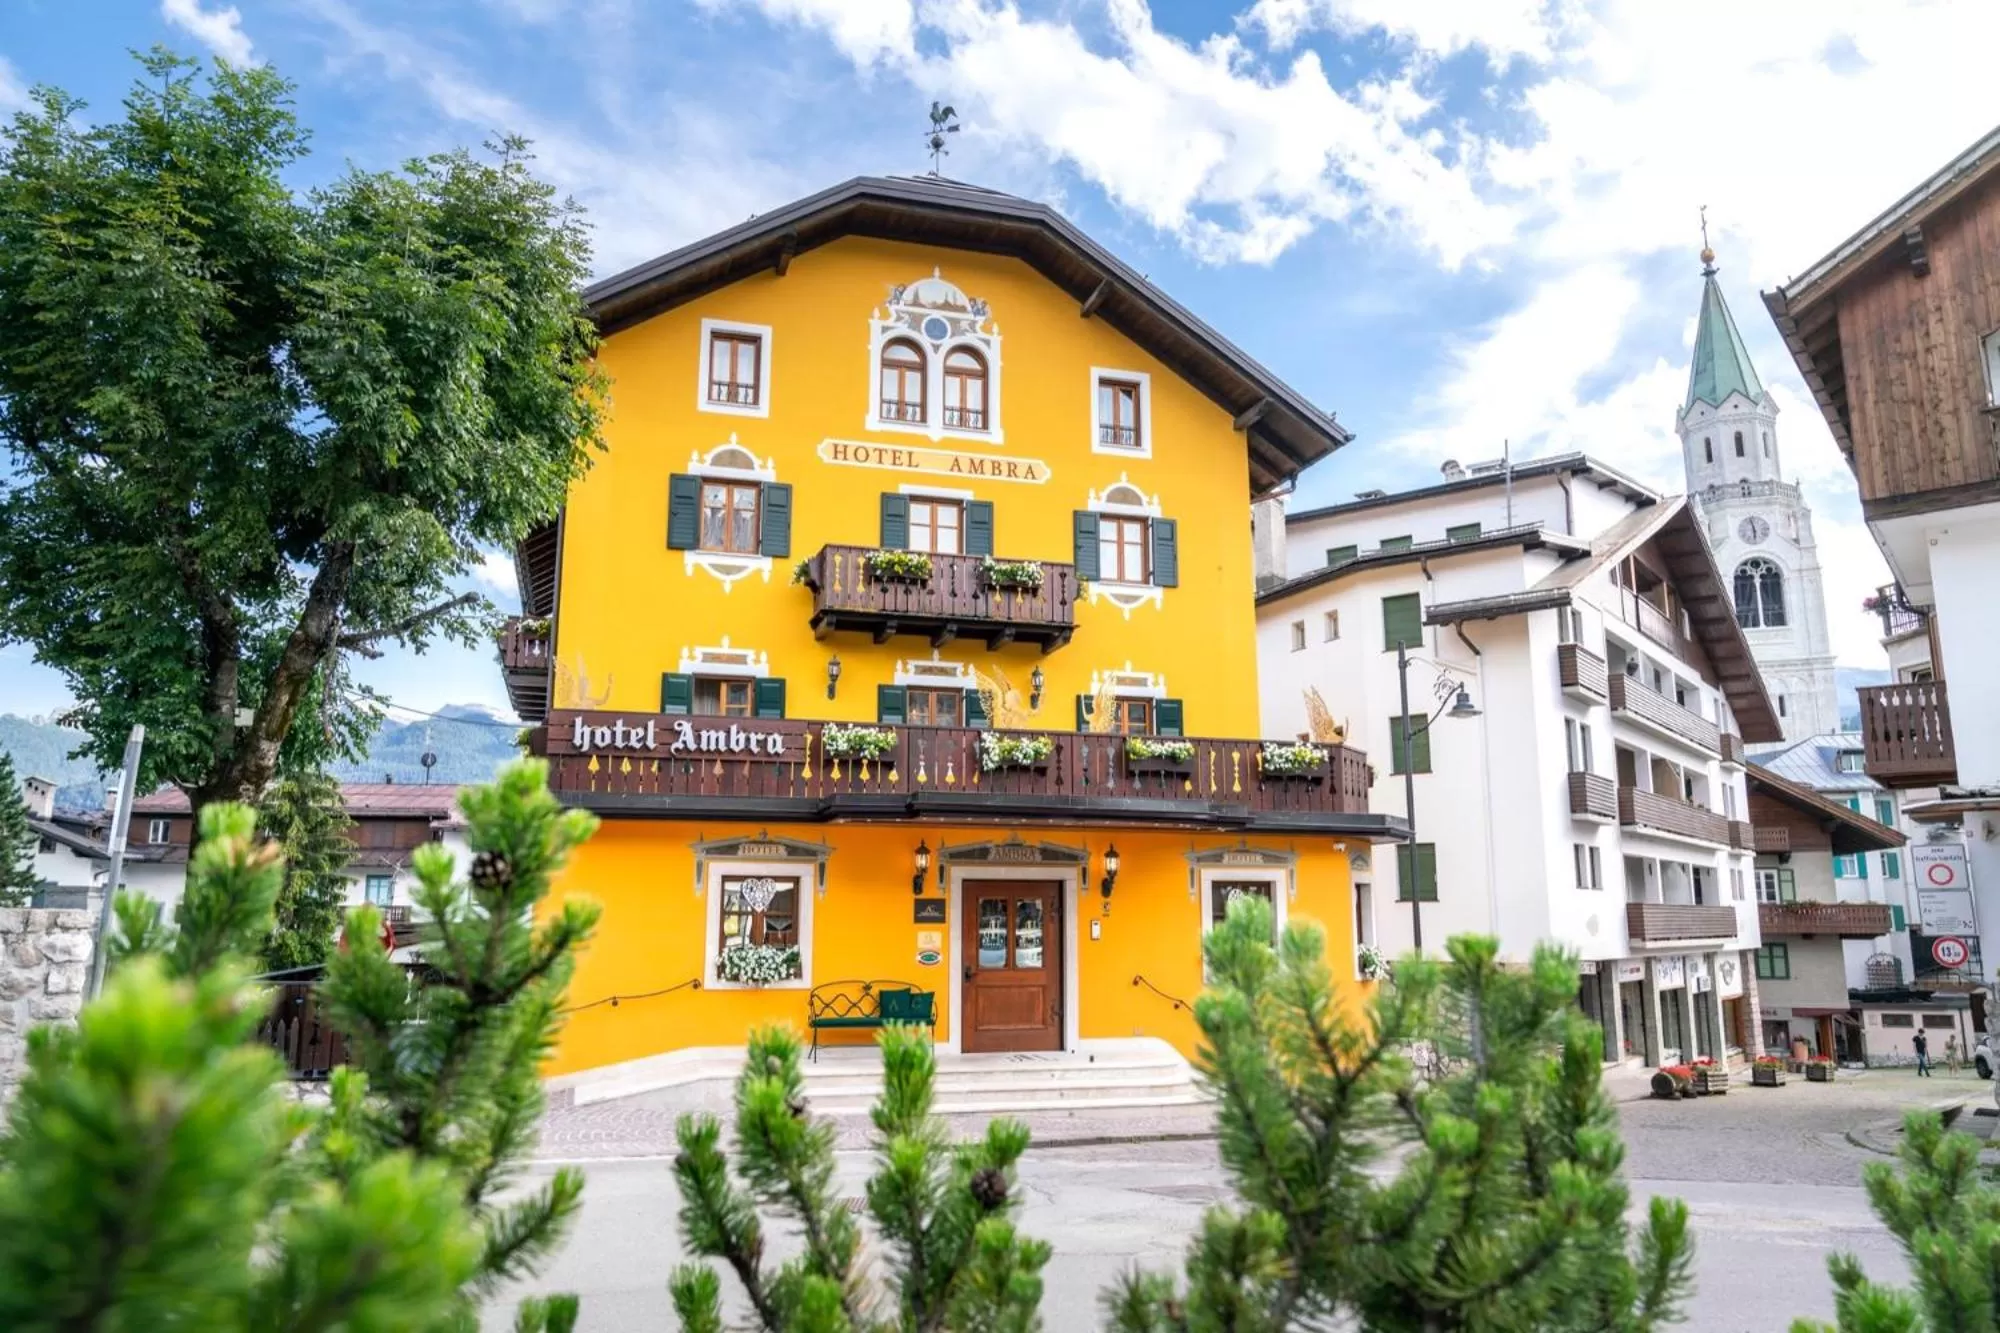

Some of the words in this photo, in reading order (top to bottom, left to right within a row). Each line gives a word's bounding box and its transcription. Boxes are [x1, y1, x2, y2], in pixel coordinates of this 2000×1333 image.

[832, 443, 920, 468] HOTEL
[949, 455, 1039, 480] AMBRA
[572, 715, 658, 752] hotel
[670, 720, 786, 756] Ambra
